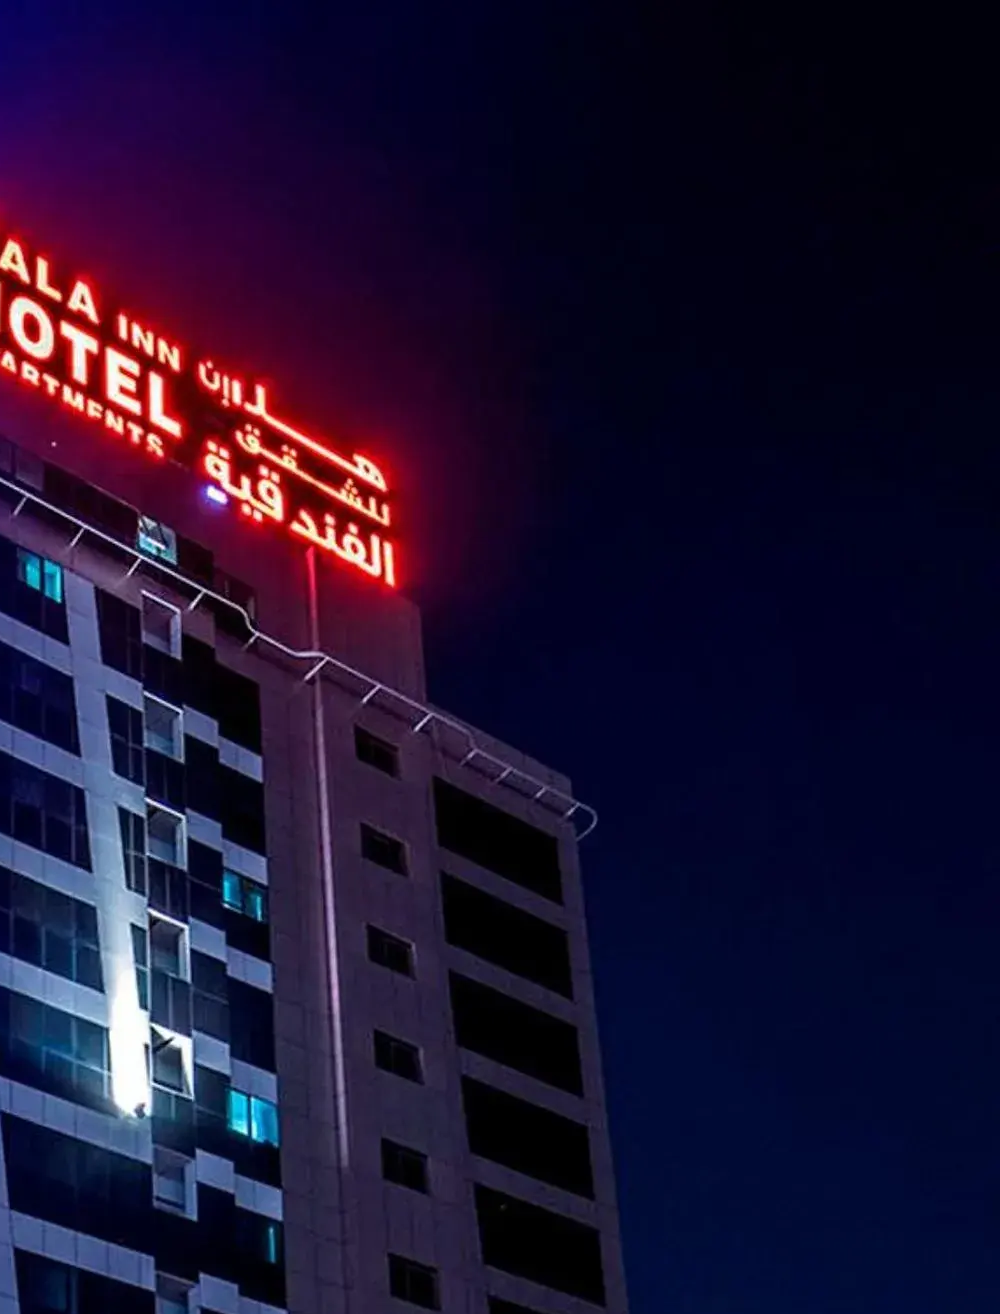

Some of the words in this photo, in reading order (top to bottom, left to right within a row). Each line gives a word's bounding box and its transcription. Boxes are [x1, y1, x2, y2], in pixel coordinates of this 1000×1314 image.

[118, 313, 181, 373] INN
[204, 440, 395, 587] الفندقية
[236, 423, 390, 527] للشقق
